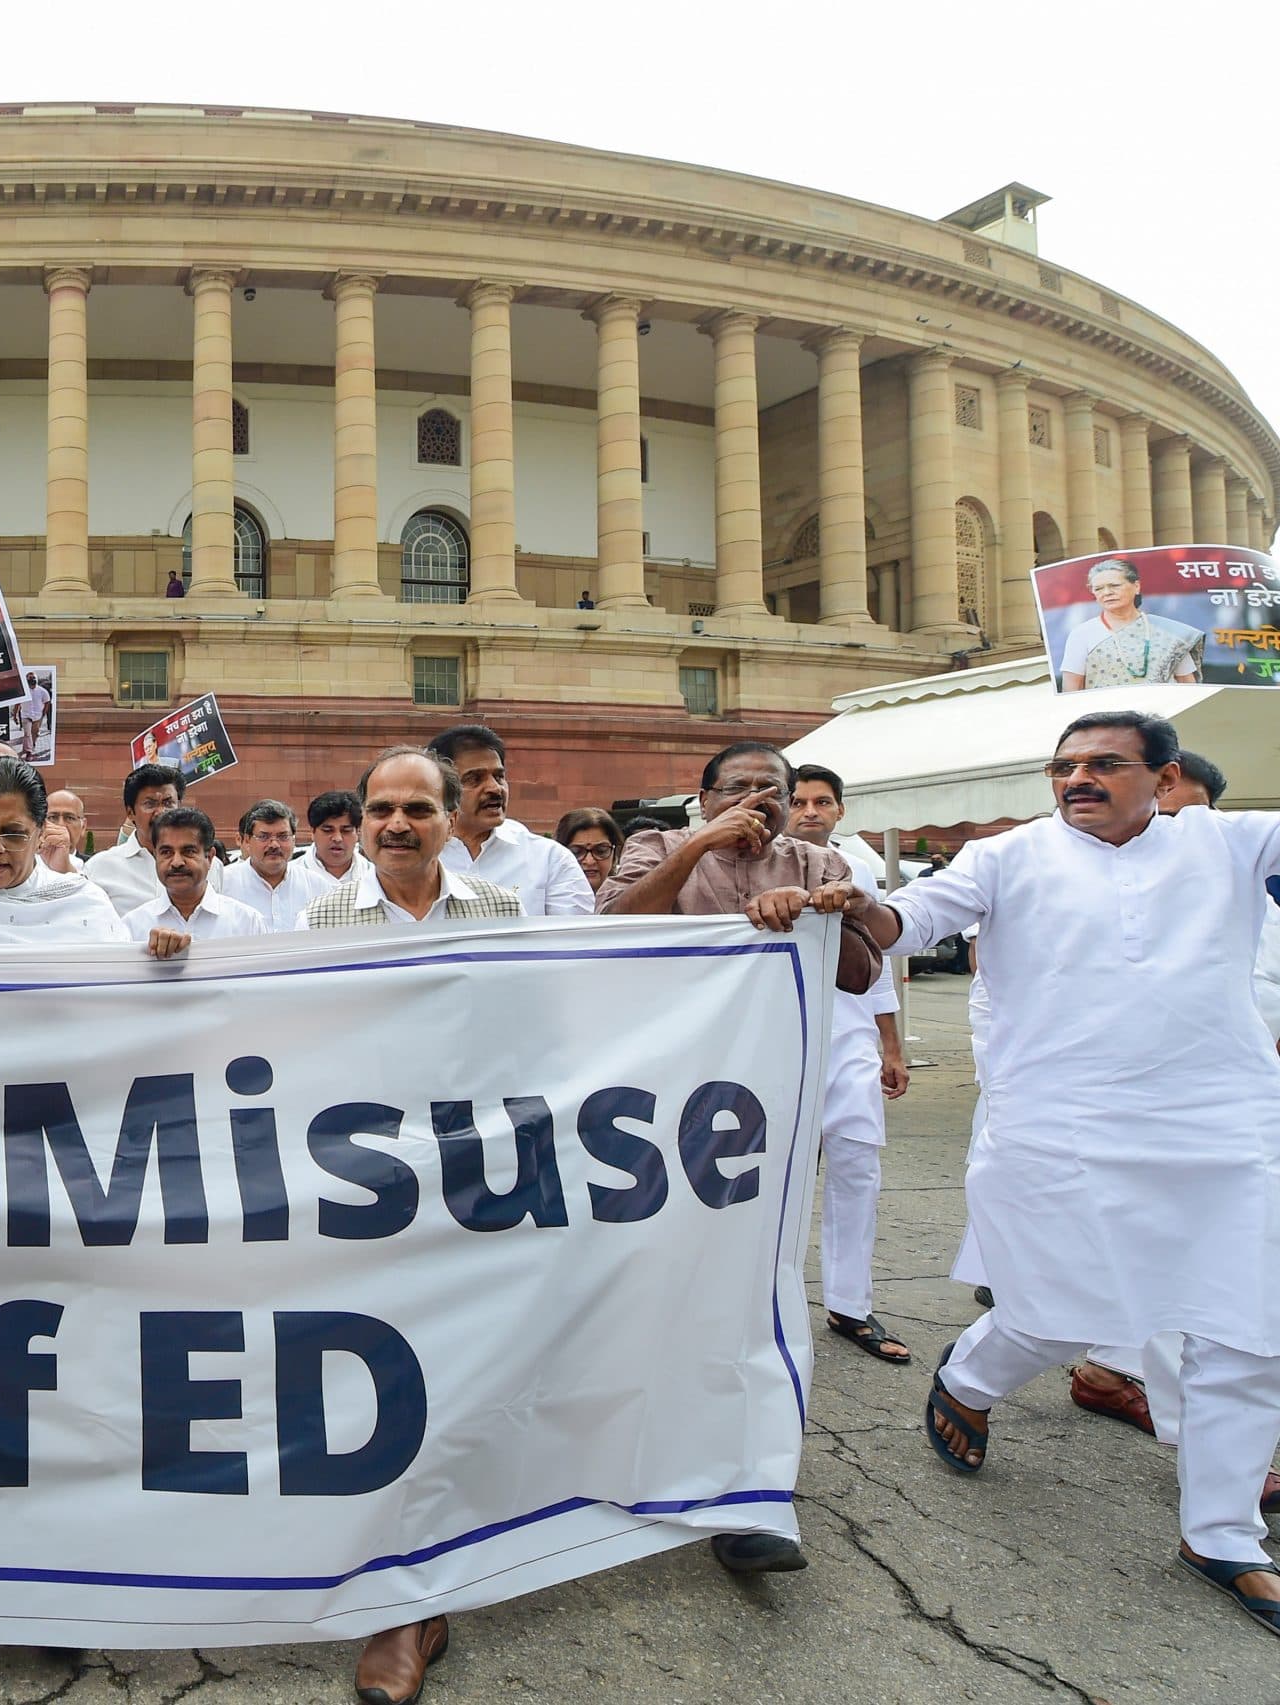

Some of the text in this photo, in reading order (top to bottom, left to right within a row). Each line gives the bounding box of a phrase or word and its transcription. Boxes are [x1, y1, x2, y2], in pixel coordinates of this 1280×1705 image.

[1176, 562, 1220, 578] सच
[1226, 562, 1255, 578] ना
[1208, 589, 1238, 606] ना
[165, 720, 180, 734] सच
[180, 713, 191, 726] ना
[176, 721, 208, 743] ना डरेगा
[3, 1055, 767, 1248] Misuse
[140, 1311, 428, 1497] ED
